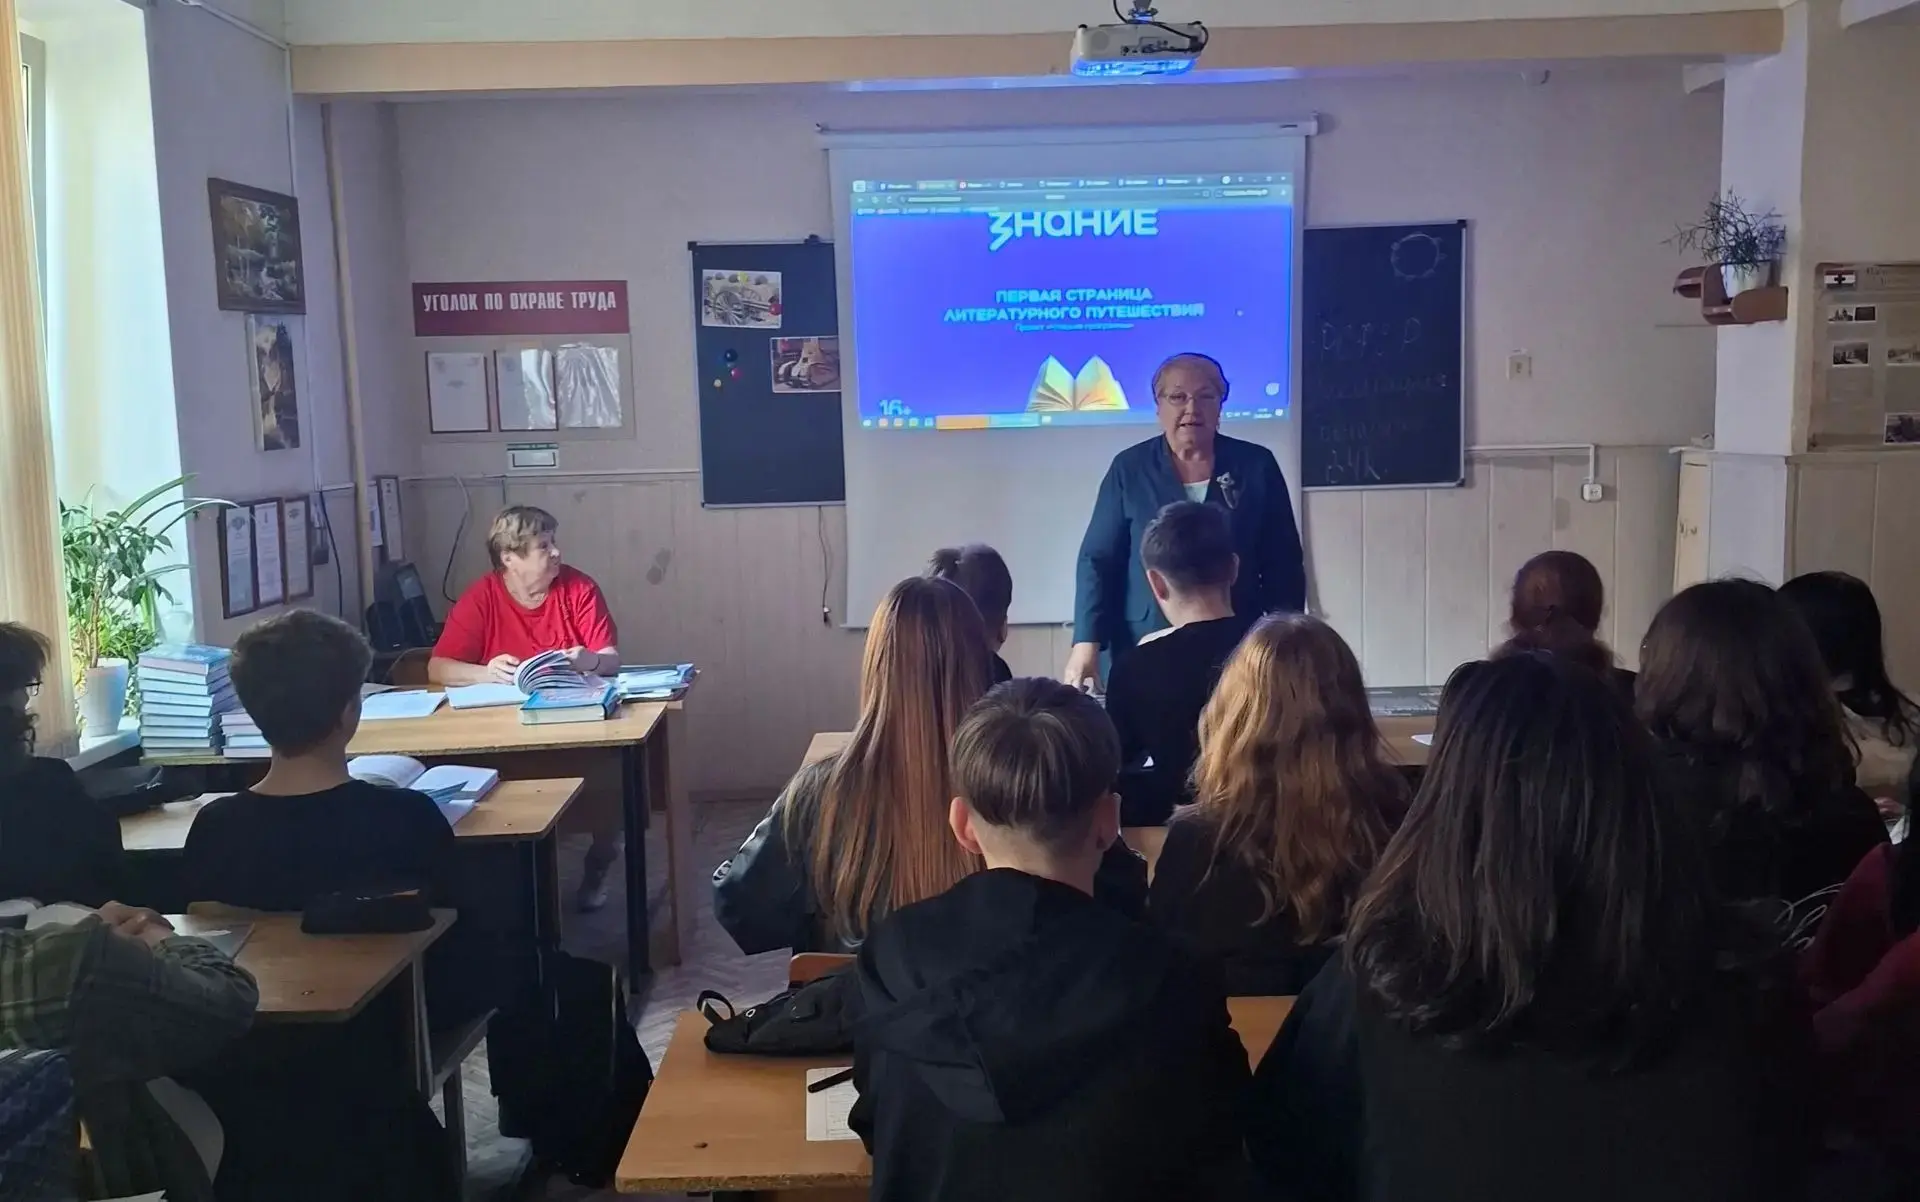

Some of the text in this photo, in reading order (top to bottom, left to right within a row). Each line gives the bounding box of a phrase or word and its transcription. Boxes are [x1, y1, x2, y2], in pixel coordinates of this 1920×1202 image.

[422, 291, 617, 312] УГОЛОК ПО ОХРАНЕ ТРУДА
[996, 288, 1153, 303] ПЕРВАЯ СТРАНИЦА
[944, 303, 1204, 322] ЛИТЕРАТУРНОГО ПУТЕШЕСТВИЯ
